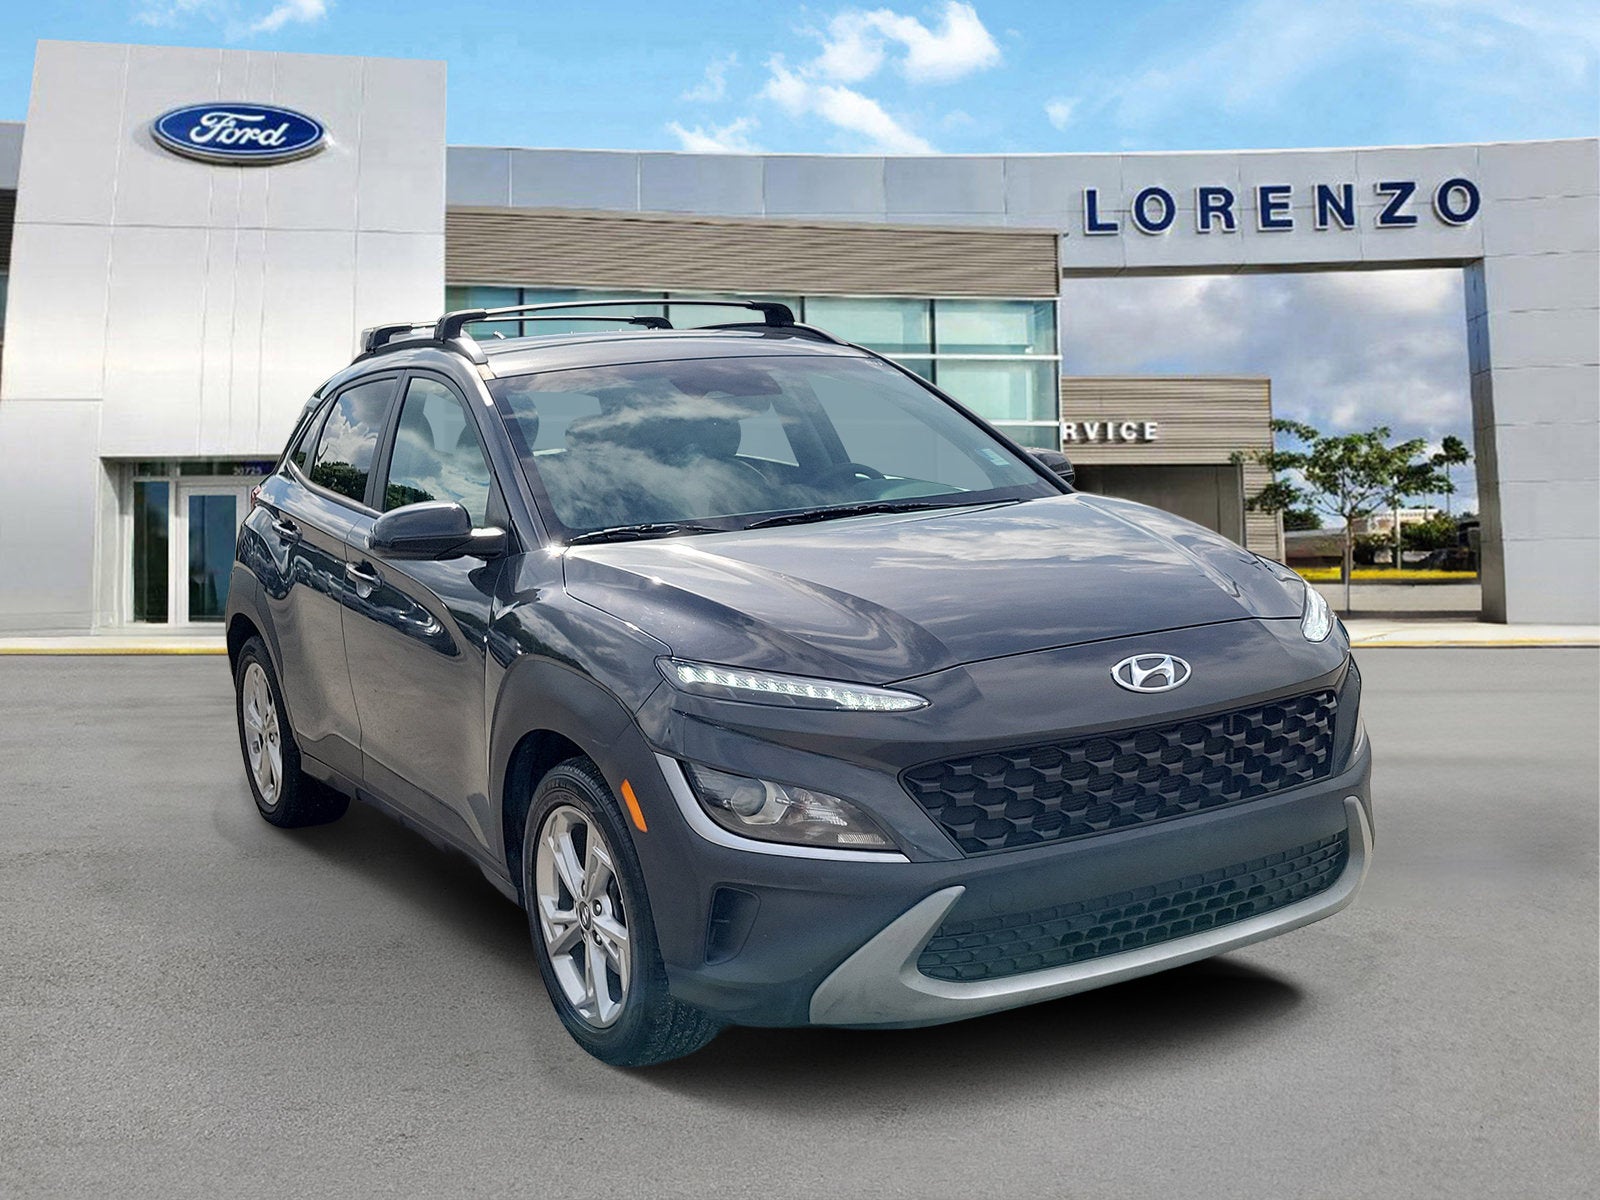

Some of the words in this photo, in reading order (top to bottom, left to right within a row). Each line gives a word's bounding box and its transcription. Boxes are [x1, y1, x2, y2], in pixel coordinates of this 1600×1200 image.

[190, 112, 290, 146] Ford
[1083, 178, 1481, 235] LORENZO
[1062, 421, 1159, 440] RVICE
